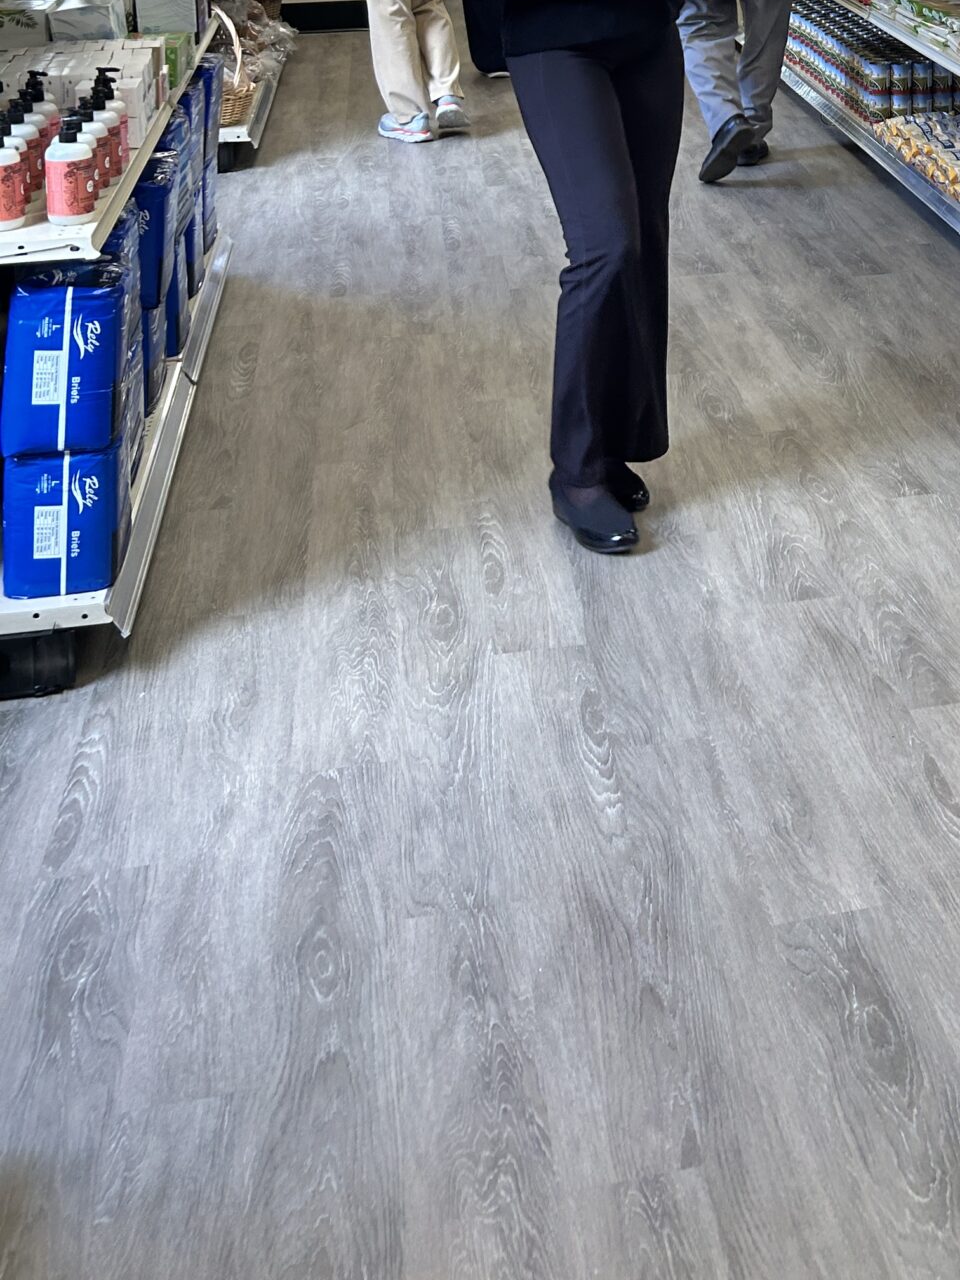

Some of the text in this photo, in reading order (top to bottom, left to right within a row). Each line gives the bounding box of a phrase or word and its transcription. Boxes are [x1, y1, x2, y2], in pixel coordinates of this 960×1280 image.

[84, 320, 101, 353] Rely
[70, 376, 80, 404] Briefs
[82, 475, 99, 507] Rely
[71, 530, 80, 558] Briefs
